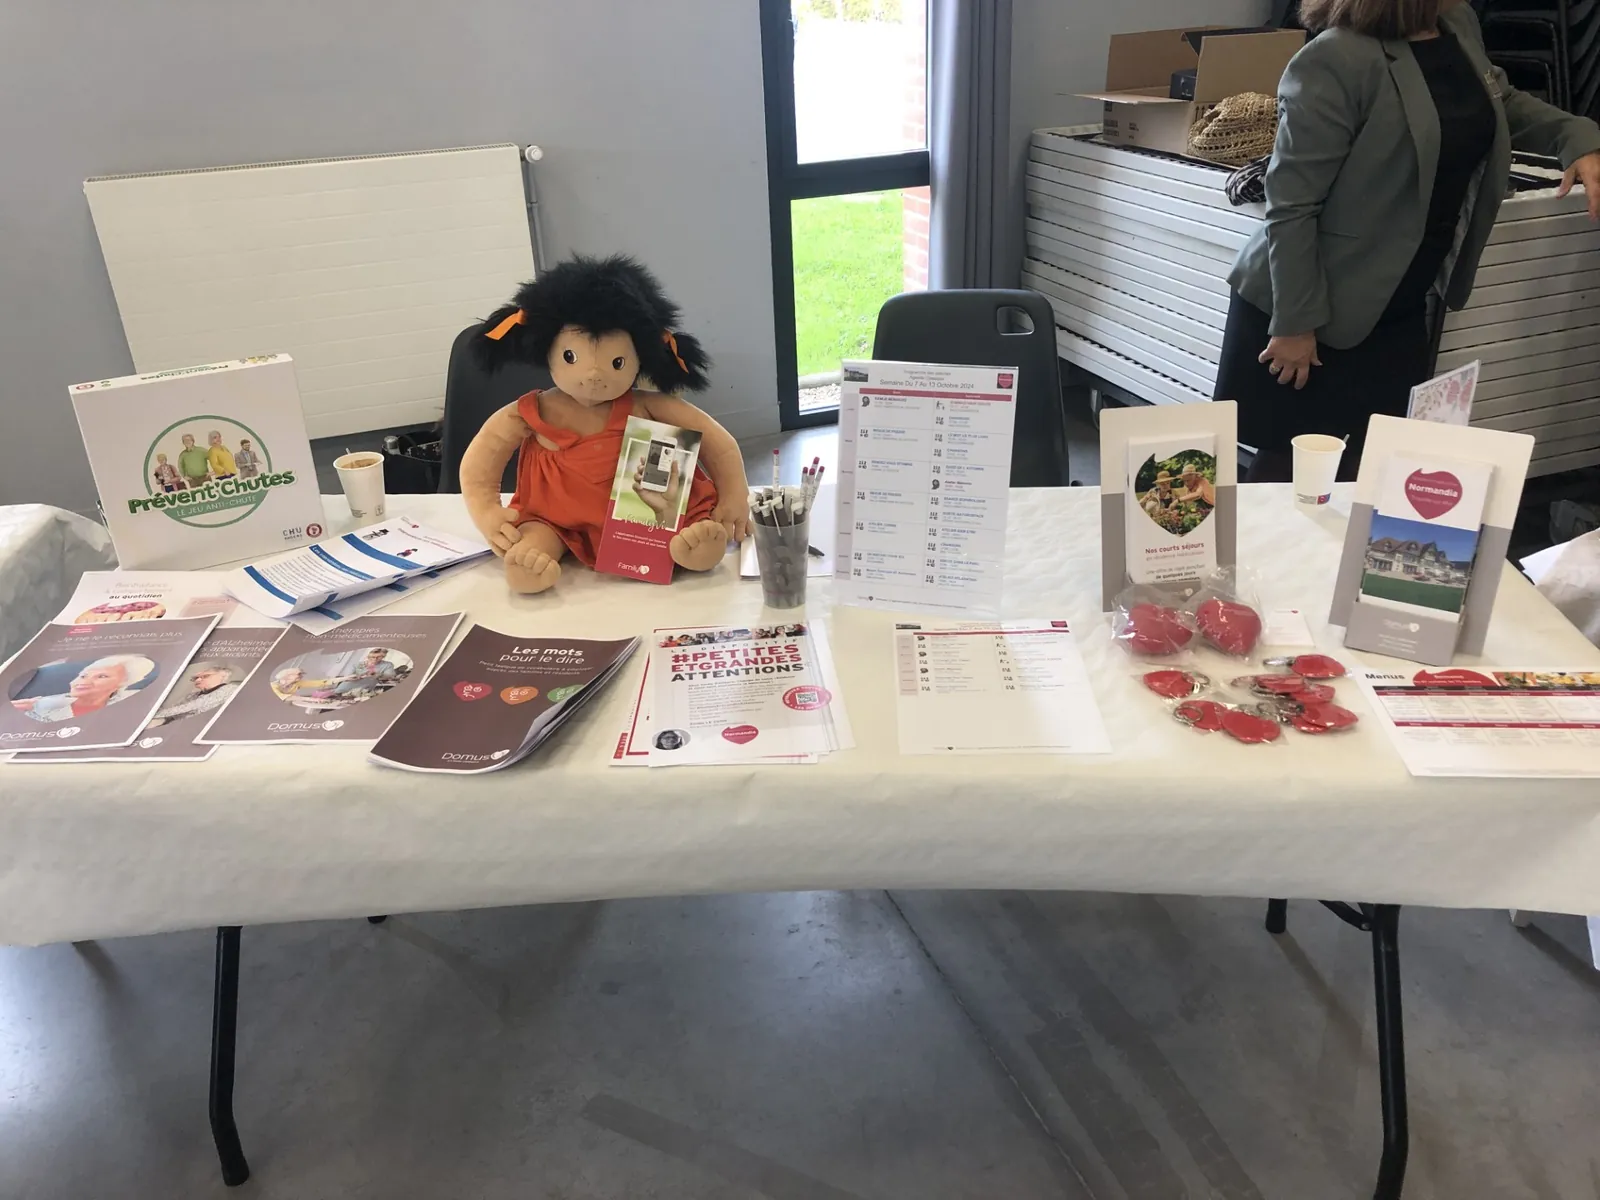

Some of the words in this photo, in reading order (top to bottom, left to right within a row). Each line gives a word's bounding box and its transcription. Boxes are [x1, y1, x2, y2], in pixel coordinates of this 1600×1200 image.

[879, 379, 904, 388] Semaine
[904, 380, 914, 388] Du
[918, 380, 928, 388] Au
[936, 381, 959, 389] Octobre
[959, 382, 975, 390] 2024
[127, 470, 296, 514] Prévent'Chutes
[1407, 482, 1459, 499] Normandia
[176, 508, 187, 518] LE
[187, 506, 204, 516] JEU
[206, 495, 258, 512] ANTI-CHUTE
[282, 526, 303, 538] CHU
[1158, 544, 1180, 553] courts
[1181, 542, 1205, 551] séjours
[617, 561, 642, 574] Family
[121, 593, 163, 601] quotidien
[512, 646, 539, 655] Les
[543, 647, 584, 657] mots
[671, 643, 800, 664] #PETITES
[499, 654, 537, 663] pour
[538, 655, 553, 663] le
[555, 655, 585, 665] dire
[671, 653, 802, 673] ETGRANDES
[671, 663, 804, 683] ATTENTIONS
[1364, 673, 1406, 681] Menus
[267, 722, 321, 733] Domus
[0, 732, 56, 742] Domus
[441, 752, 490, 762] Domus
